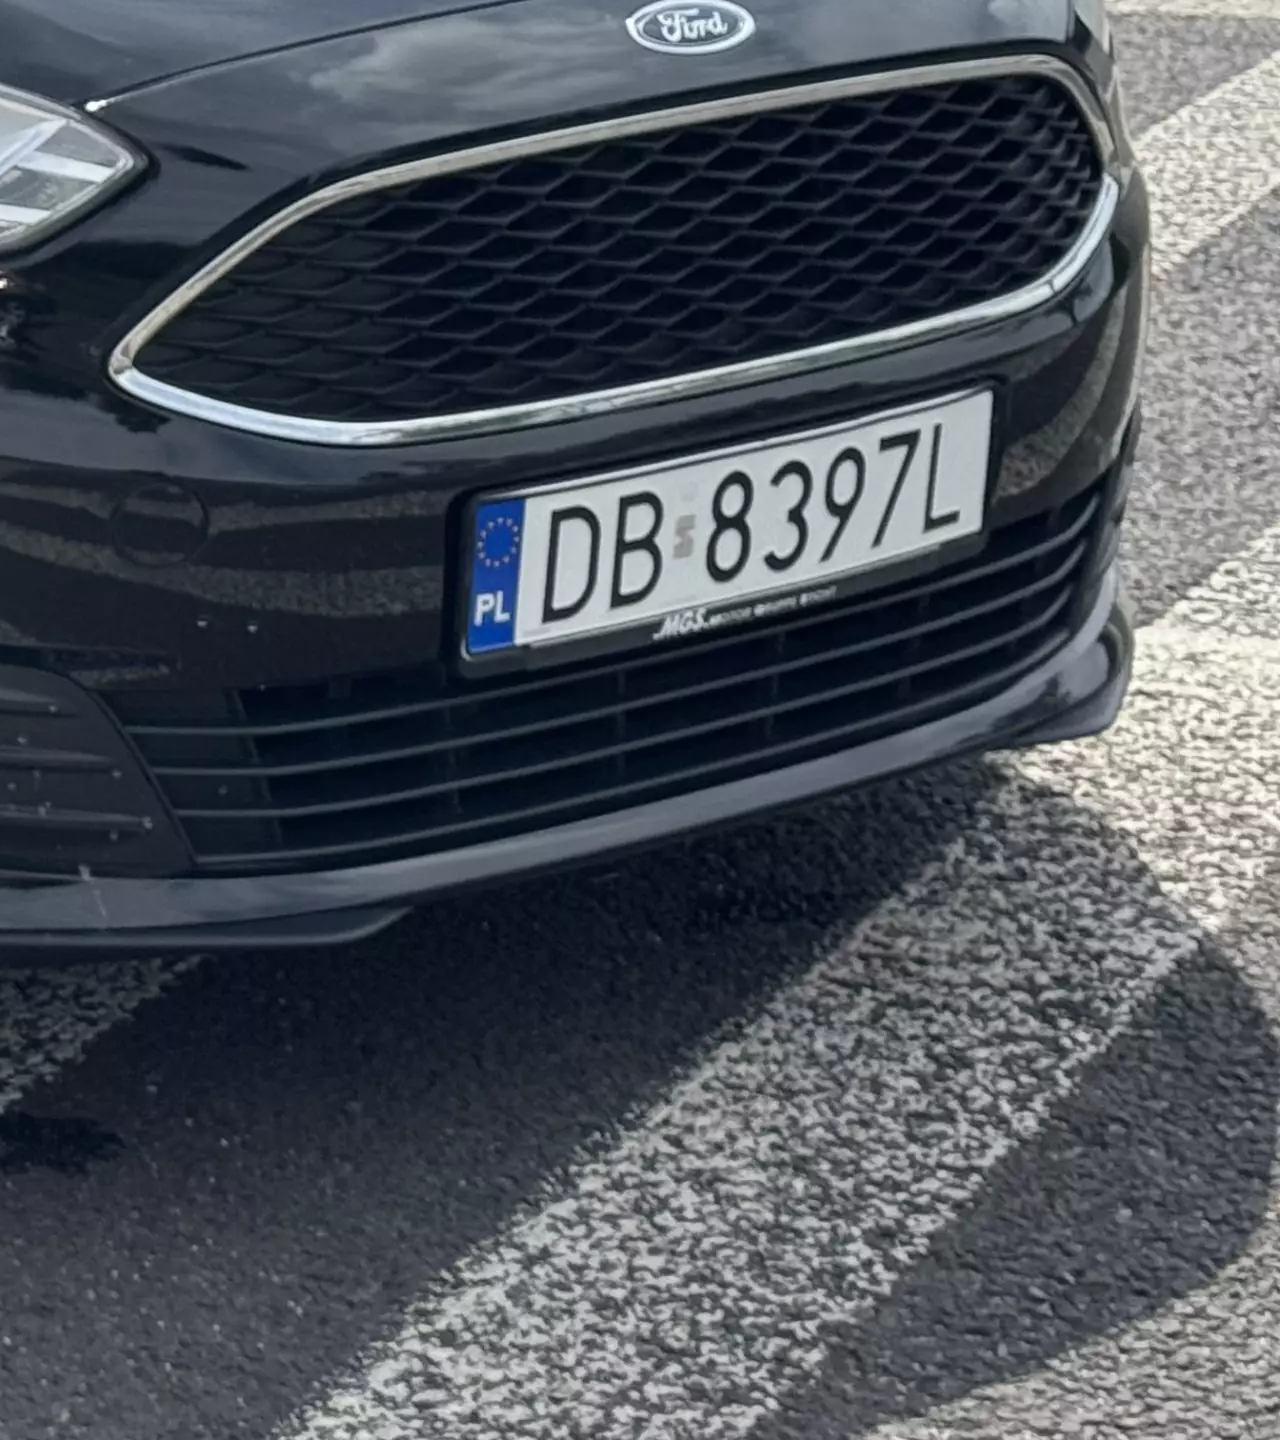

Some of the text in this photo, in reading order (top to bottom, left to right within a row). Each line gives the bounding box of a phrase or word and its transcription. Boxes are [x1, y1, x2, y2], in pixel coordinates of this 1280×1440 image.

[657, 8, 728, 42] Ford
[541, 423, 960, 623] DB 8397L
[474, 593, 511, 626] PL
